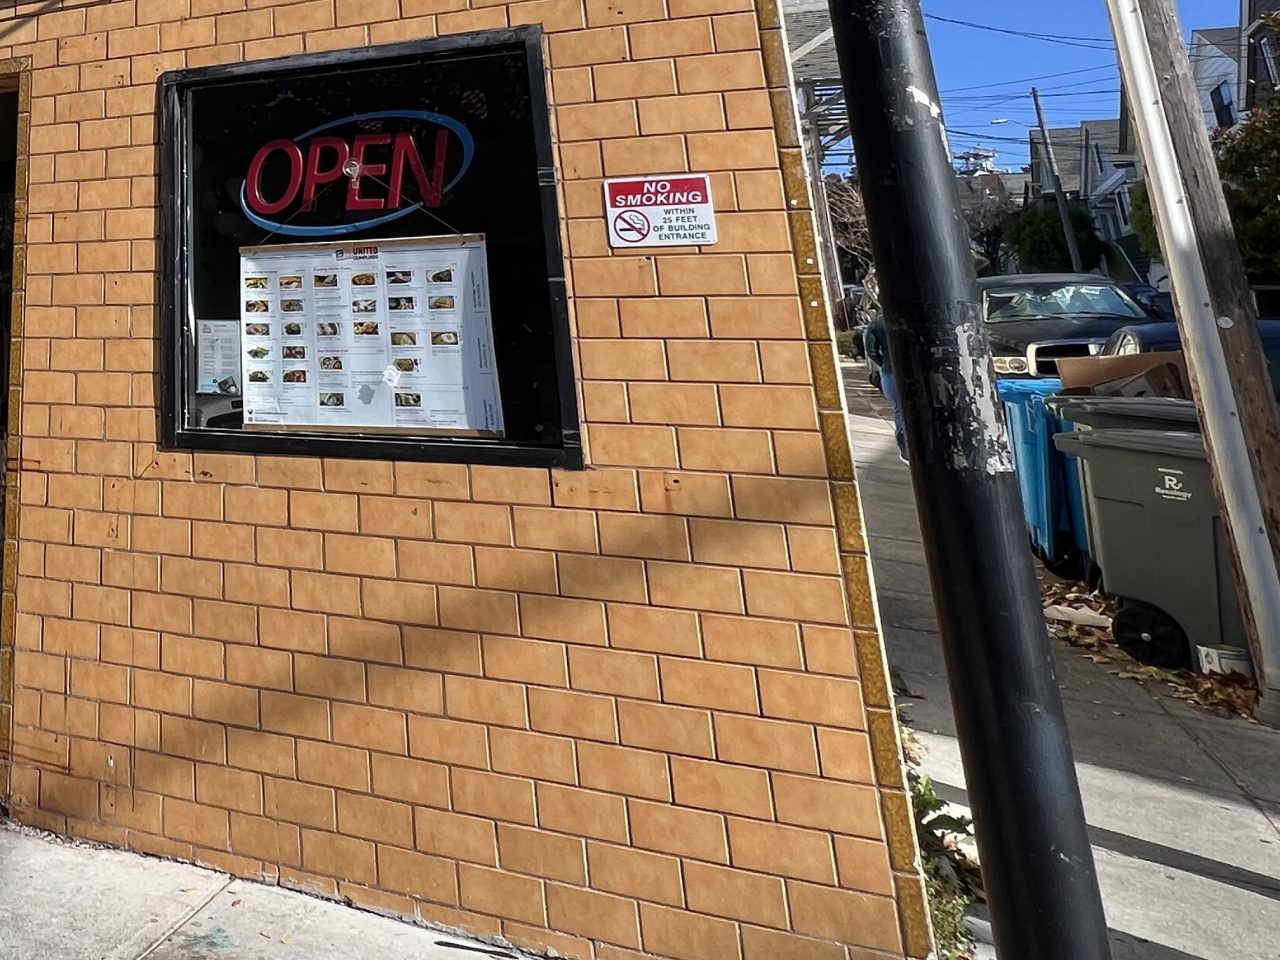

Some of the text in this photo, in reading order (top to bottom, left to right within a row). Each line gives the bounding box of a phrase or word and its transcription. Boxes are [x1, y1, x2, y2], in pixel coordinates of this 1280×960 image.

[245, 129, 450, 215] OPEN
[643, 181, 671, 193] NO
[615, 191, 702, 207] SMOKING
[663, 207, 695, 215] WITHIN
[675, 215, 697, 223] FEET
[667, 224, 711, 232] BUILDING
[658, 231, 707, 240] ENTRANCE
[352, 246, 379, 255] UNITED
